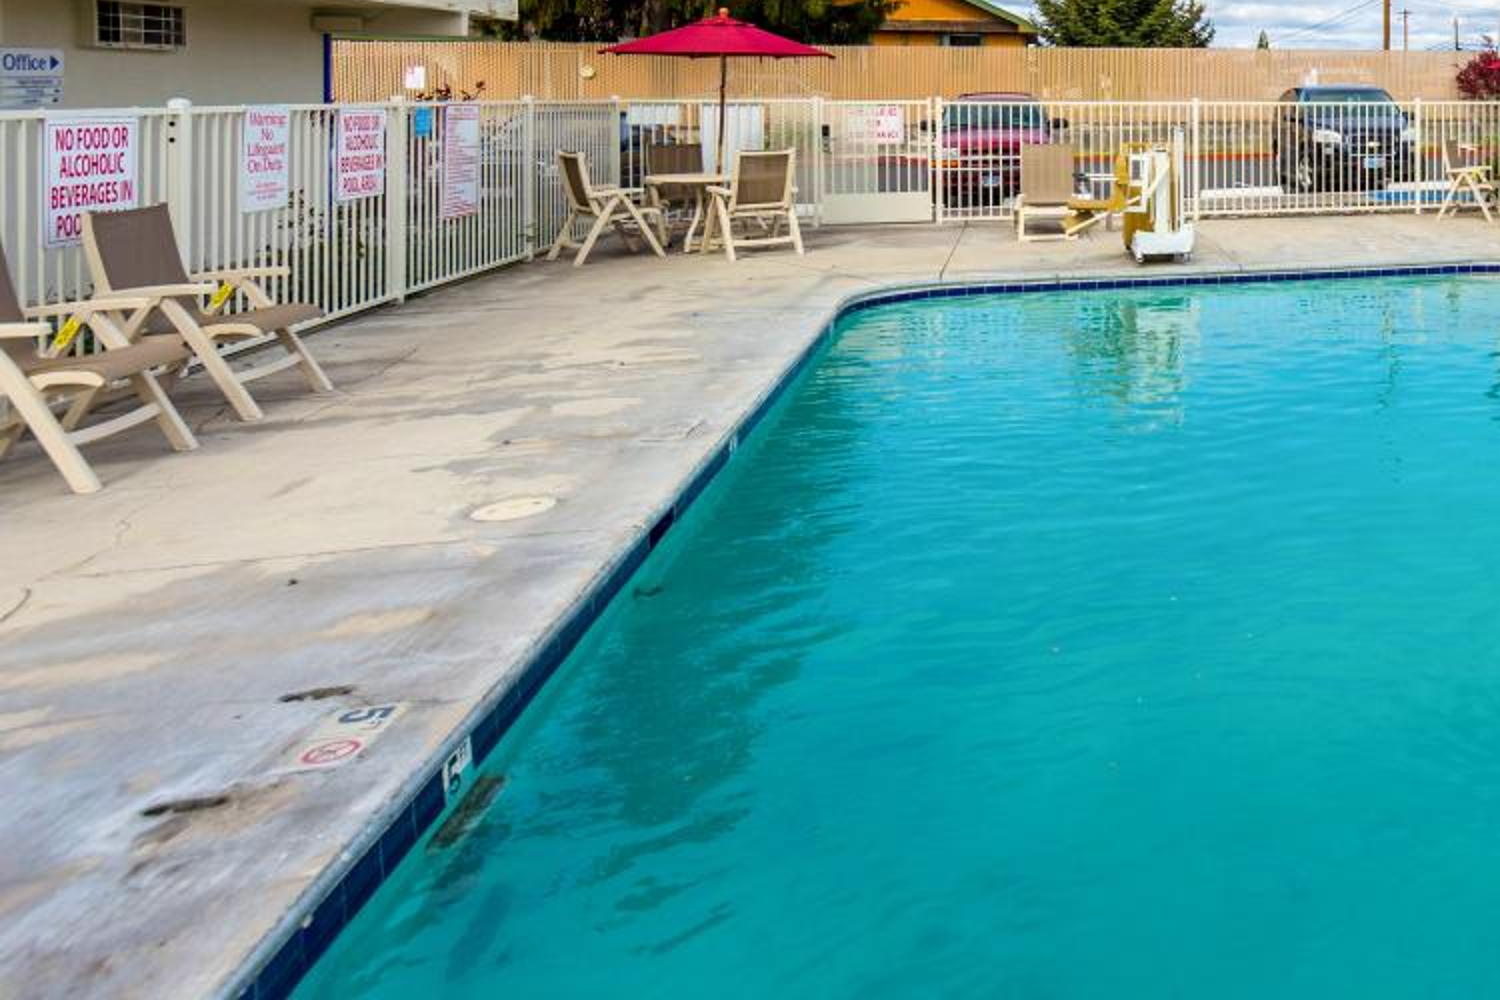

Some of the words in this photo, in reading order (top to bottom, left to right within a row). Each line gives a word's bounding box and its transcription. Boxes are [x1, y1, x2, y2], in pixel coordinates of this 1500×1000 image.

[3, 53, 47, 71] Office
[55, 128, 74, 151] NO
[77, 128, 110, 150] FOOD
[111, 127, 129, 149] OR
[59, 152, 125, 178] ALCOHOLIC
[51, 181, 118, 210] BEVERAGES
[120, 180, 133, 201] IN
[56, 214, 83, 238] POO
